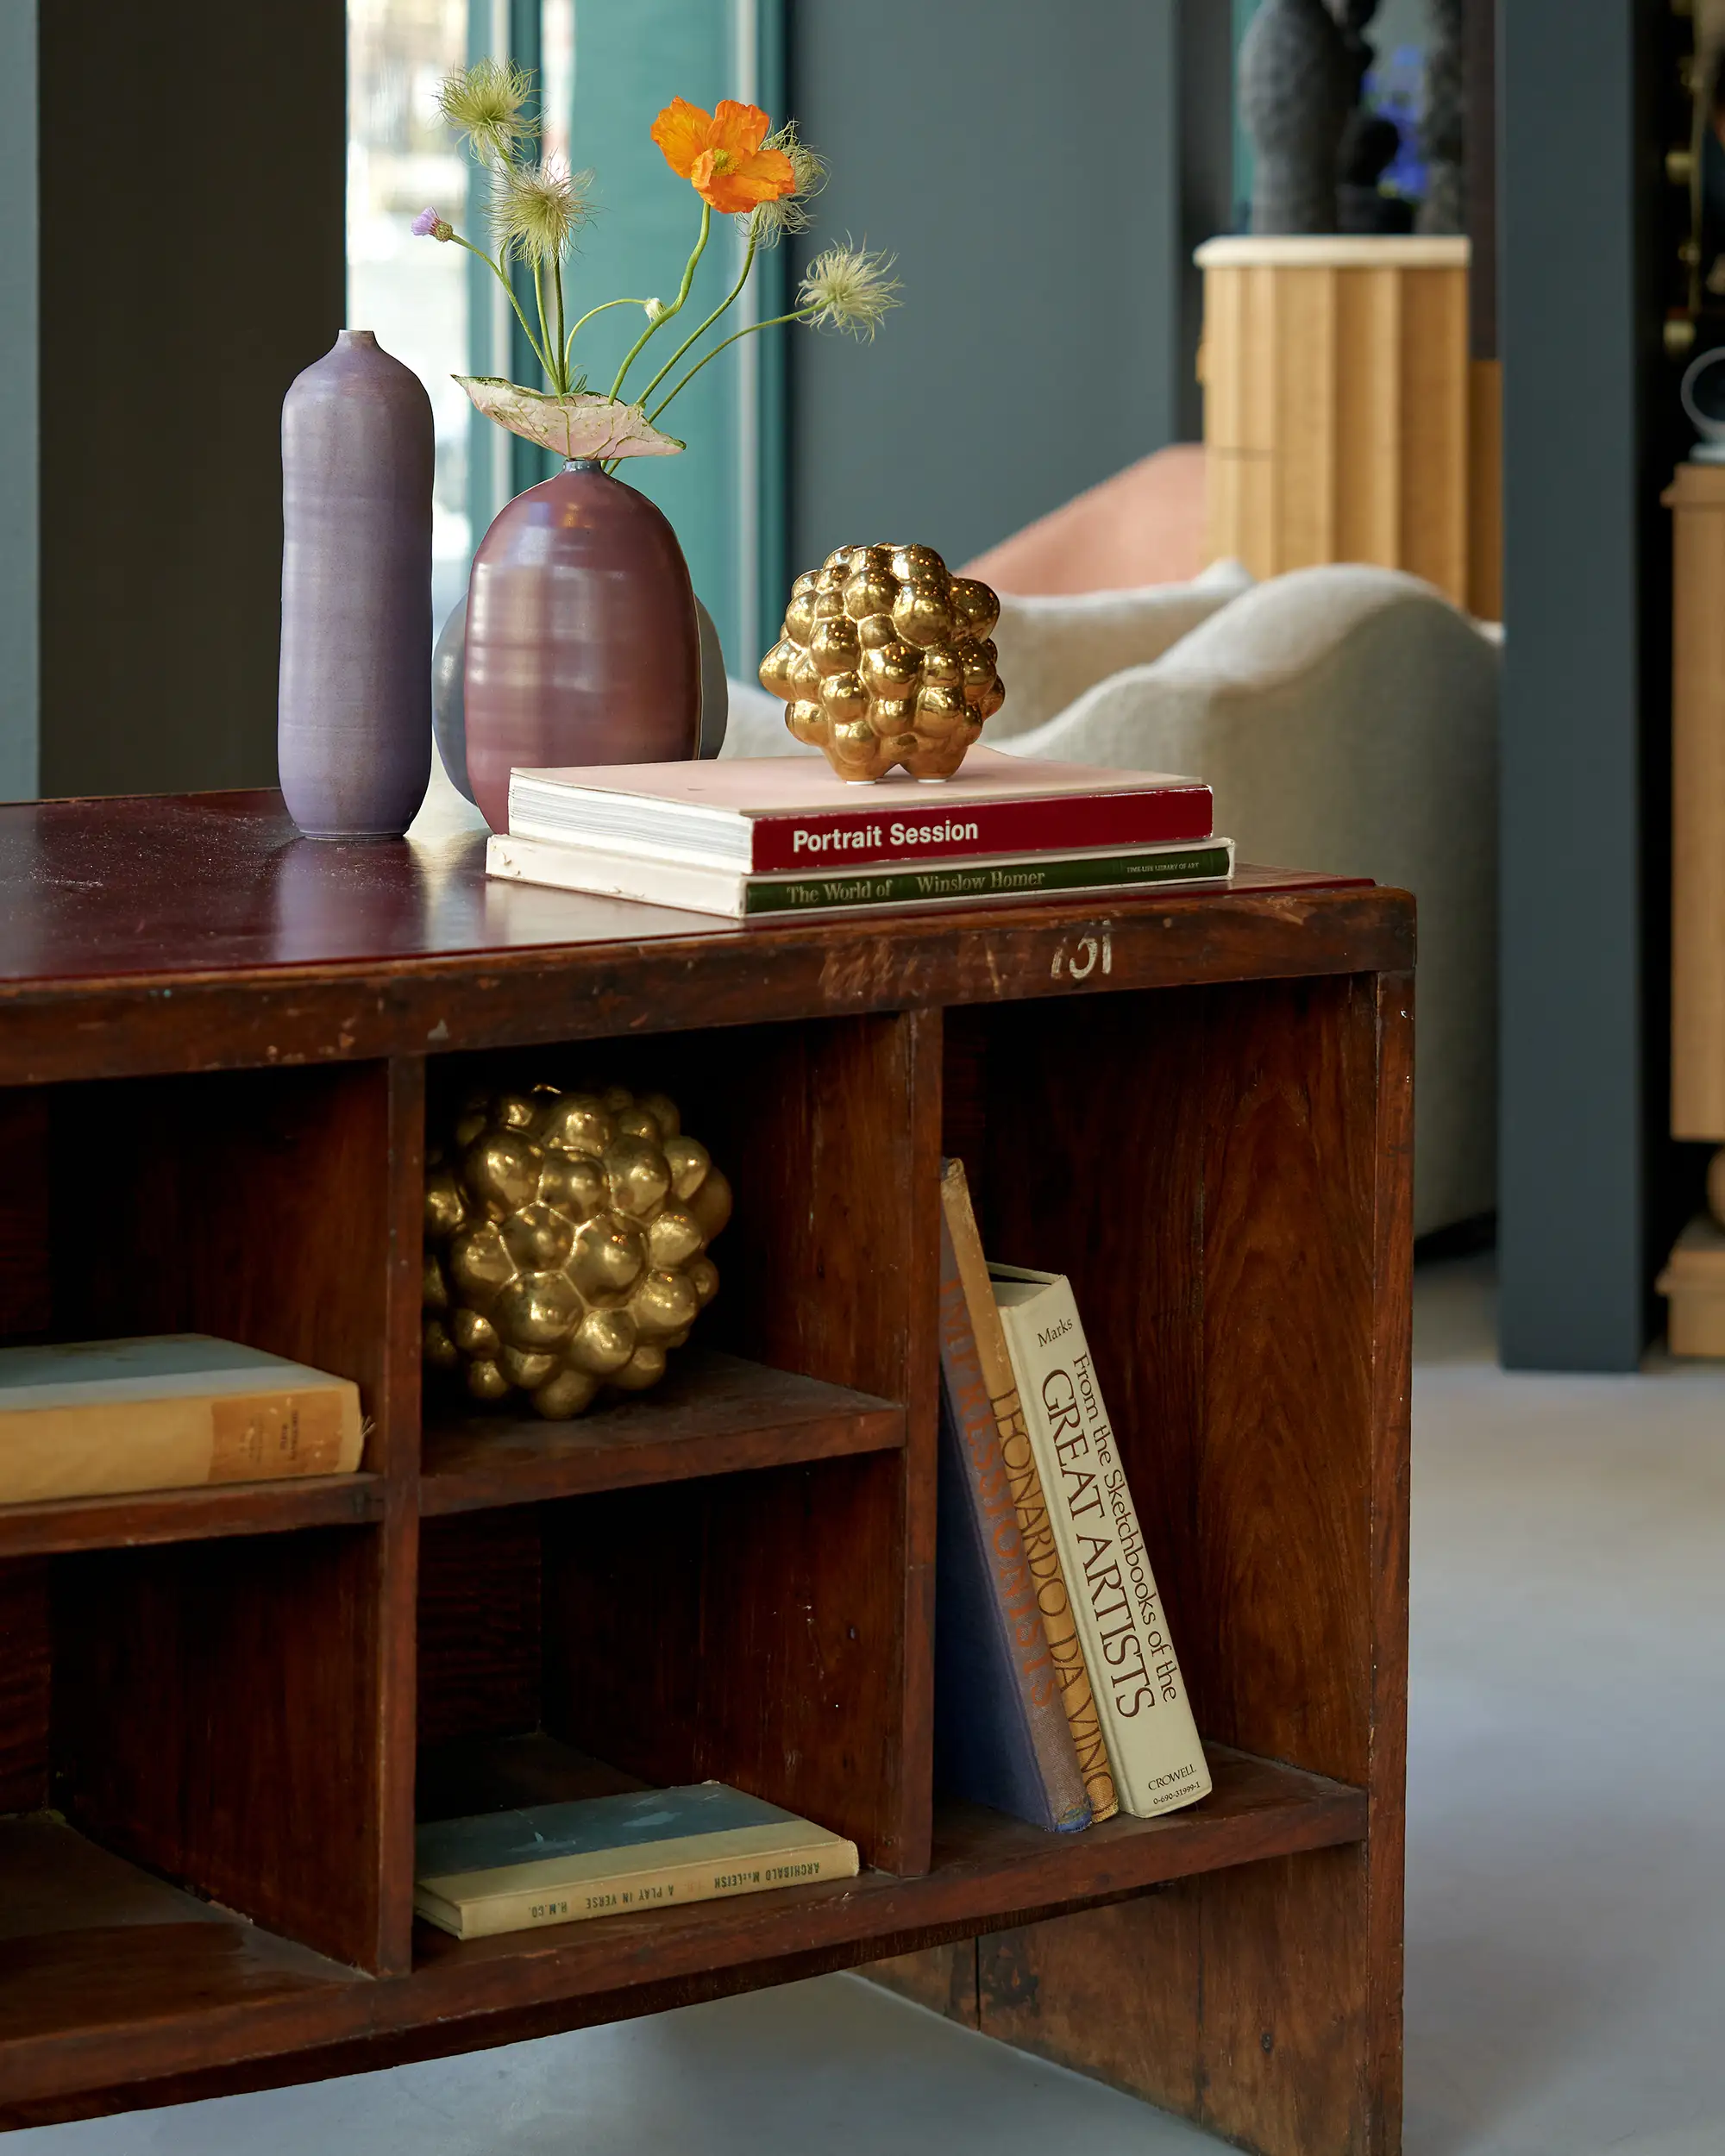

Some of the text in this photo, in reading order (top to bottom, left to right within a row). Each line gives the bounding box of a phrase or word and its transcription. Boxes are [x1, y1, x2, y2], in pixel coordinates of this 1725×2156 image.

[793, 820, 980, 853] Portrait Session
[787, 869, 1046, 904] The World of Winslow Homer
[1037, 1316, 1073, 1347] Marks
[1072, 1351, 1177, 1702] From the Sketchbooks of the
[989, 1388, 1068, 1617] LEONARDO
[1049, 1632, 1084, 1694] DA
[1040, 1368, 1157, 1719] GREAT ARTISTS
[1148, 1764, 1196, 1790] CROWELL
[1153, 1782, 1201, 1805] 0-690-31999-1
[586, 1894, 618, 1909] VERSE
[622, 1892, 633, 1904] IN
[638, 1886, 662, 1902] PLAY
[668, 1884, 674, 1896] A
